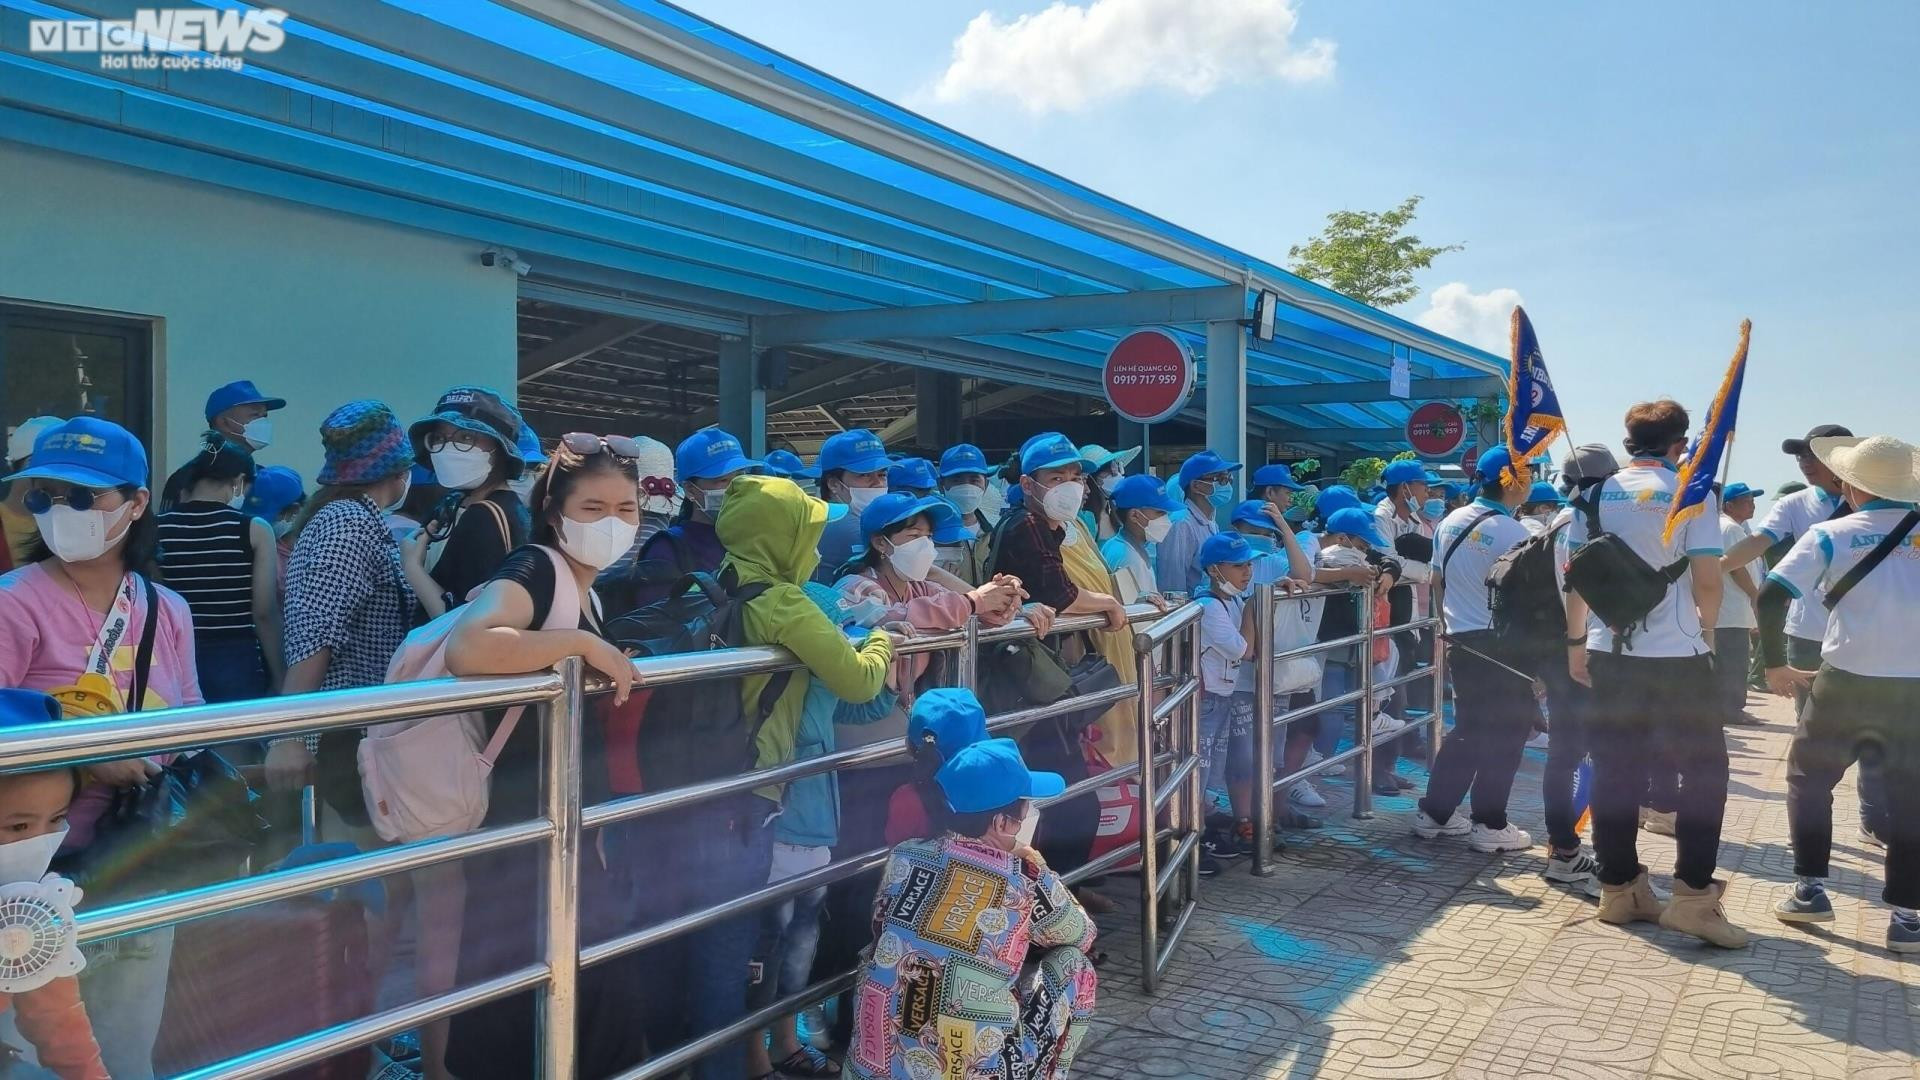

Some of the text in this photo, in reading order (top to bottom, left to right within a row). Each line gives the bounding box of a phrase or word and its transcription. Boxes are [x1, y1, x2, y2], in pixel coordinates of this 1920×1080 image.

[1113, 374, 1177, 385] 0919 717 959
[898, 870, 931, 917] VERSACE
[940, 875, 985, 933] VERSACE
[865, 994, 877, 1061] VERSACE
